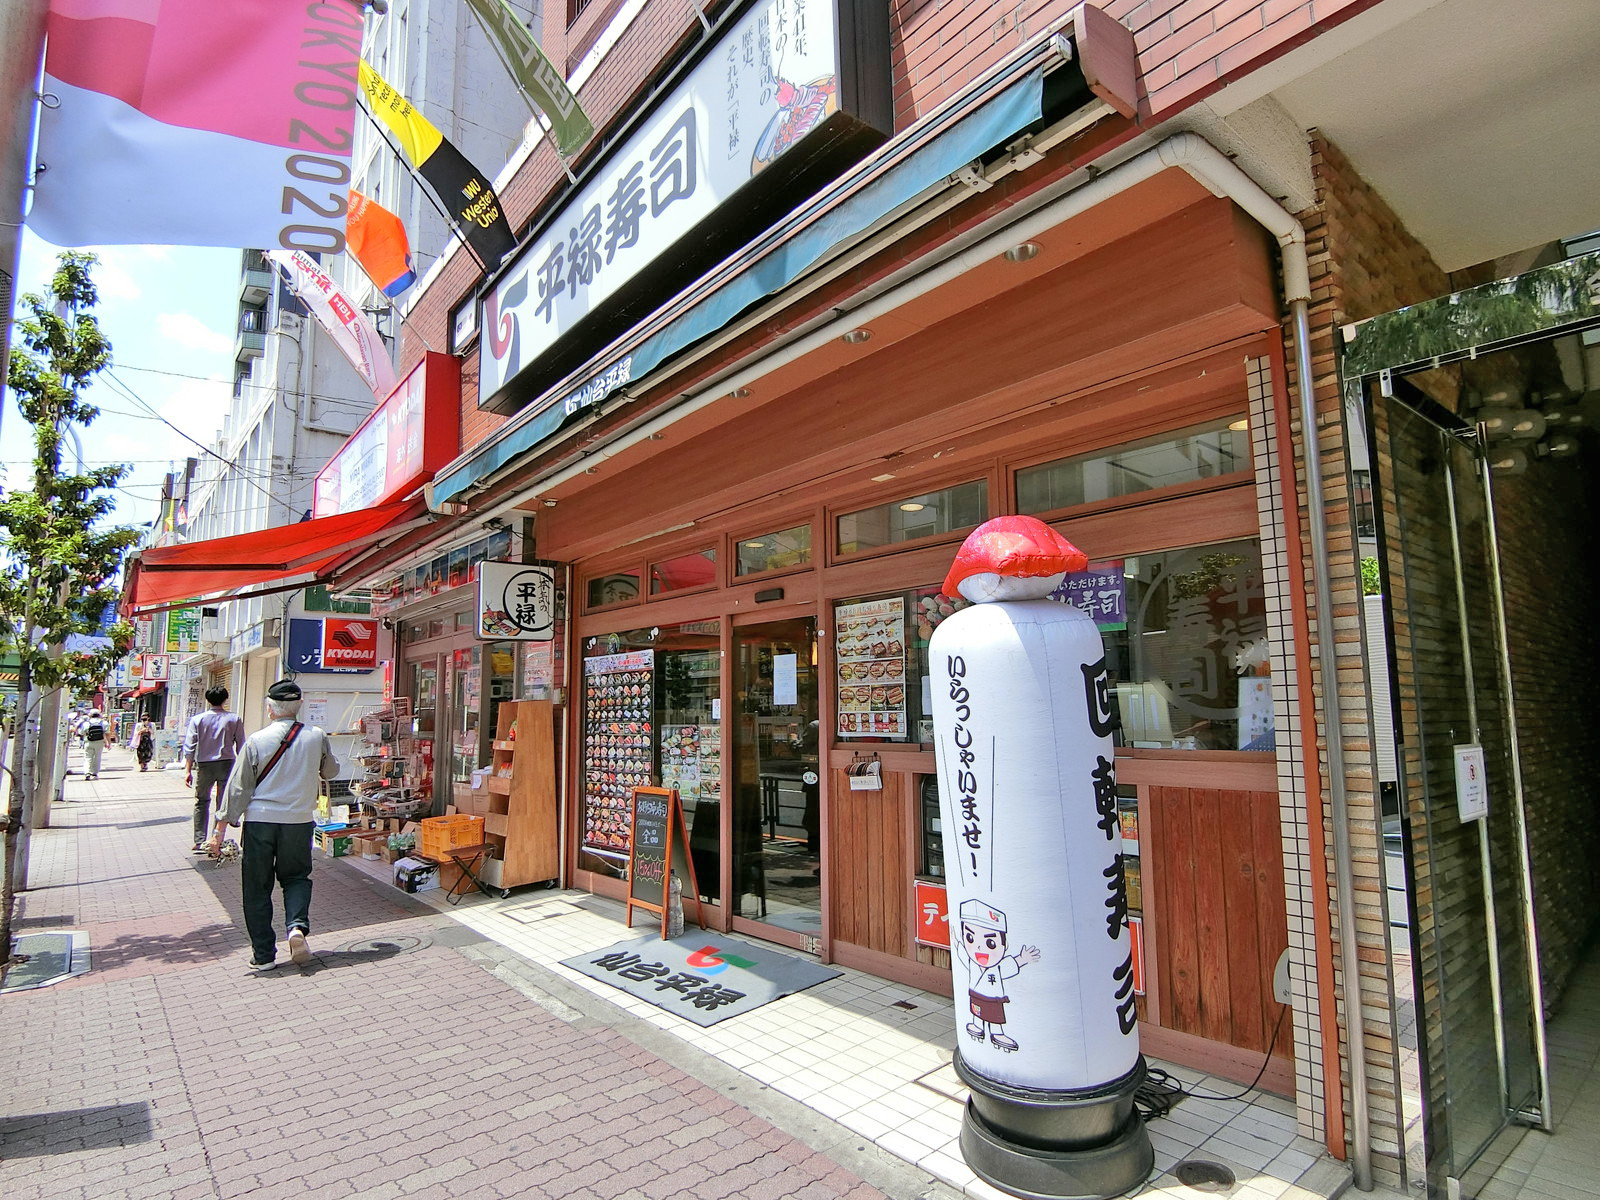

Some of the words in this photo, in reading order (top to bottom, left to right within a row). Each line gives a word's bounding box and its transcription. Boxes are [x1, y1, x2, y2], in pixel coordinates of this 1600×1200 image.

[758, 9, 771, 107] 回転寿司の
[278, 118, 354, 256] 2020
[535, 106, 697, 325] 平禄寿司
[291, 255, 332, 295] remit
[333, 296, 351, 321] HBL
[516, 582, 537, 625] 平禄
[538, 577, 551, 612] 本気の
[326, 648, 375, 659] KYODAI
[642, 828, 659, 844] 全品
[589, 950, 747, 1011] 仙台平禄
[987, 973, 997, 986] 平
